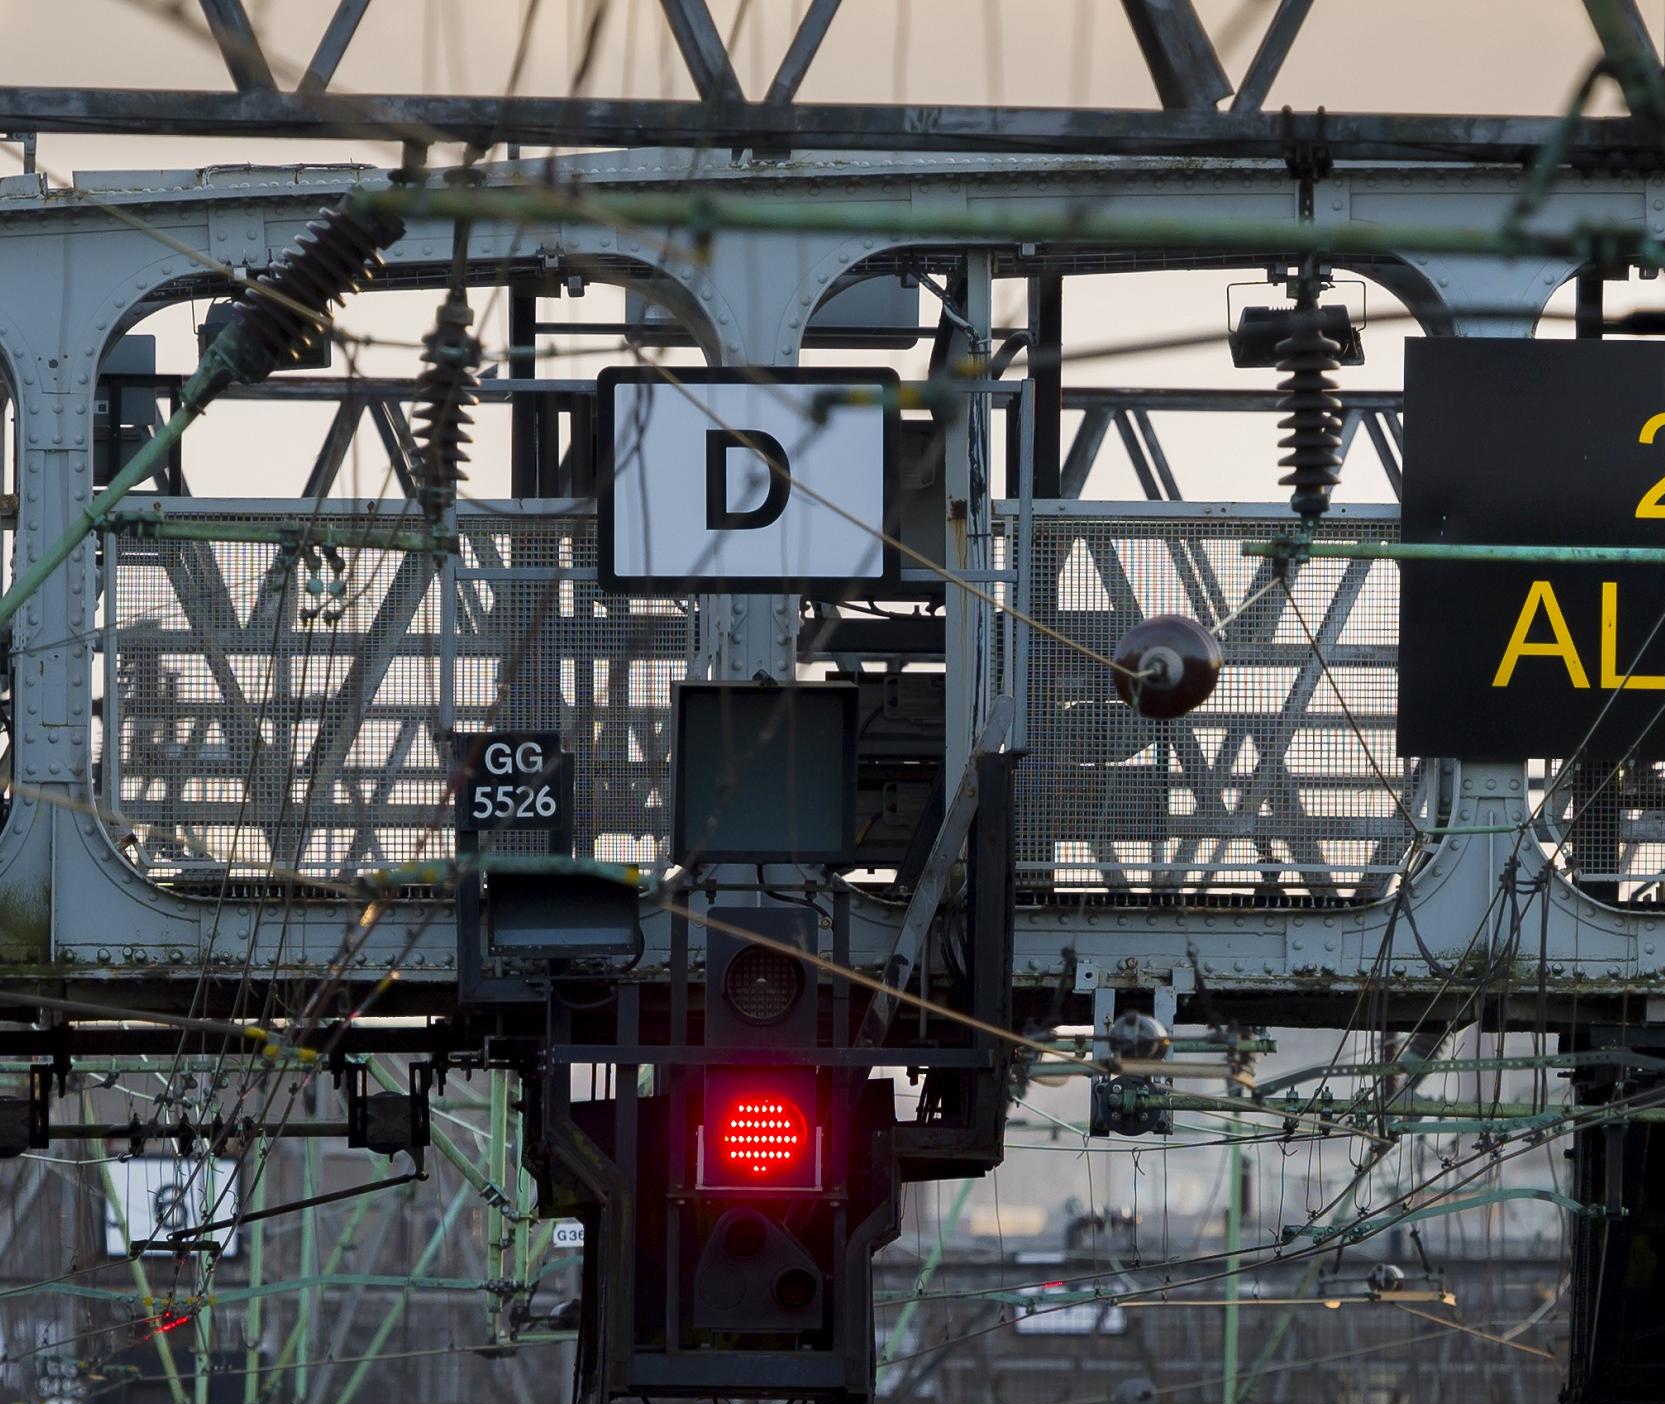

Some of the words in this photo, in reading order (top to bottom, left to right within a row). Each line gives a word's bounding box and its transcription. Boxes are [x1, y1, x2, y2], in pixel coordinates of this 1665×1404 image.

[706, 429, 791, 530] D
[484, 741, 543, 775] GG
[472, 784, 557, 819] 5526
